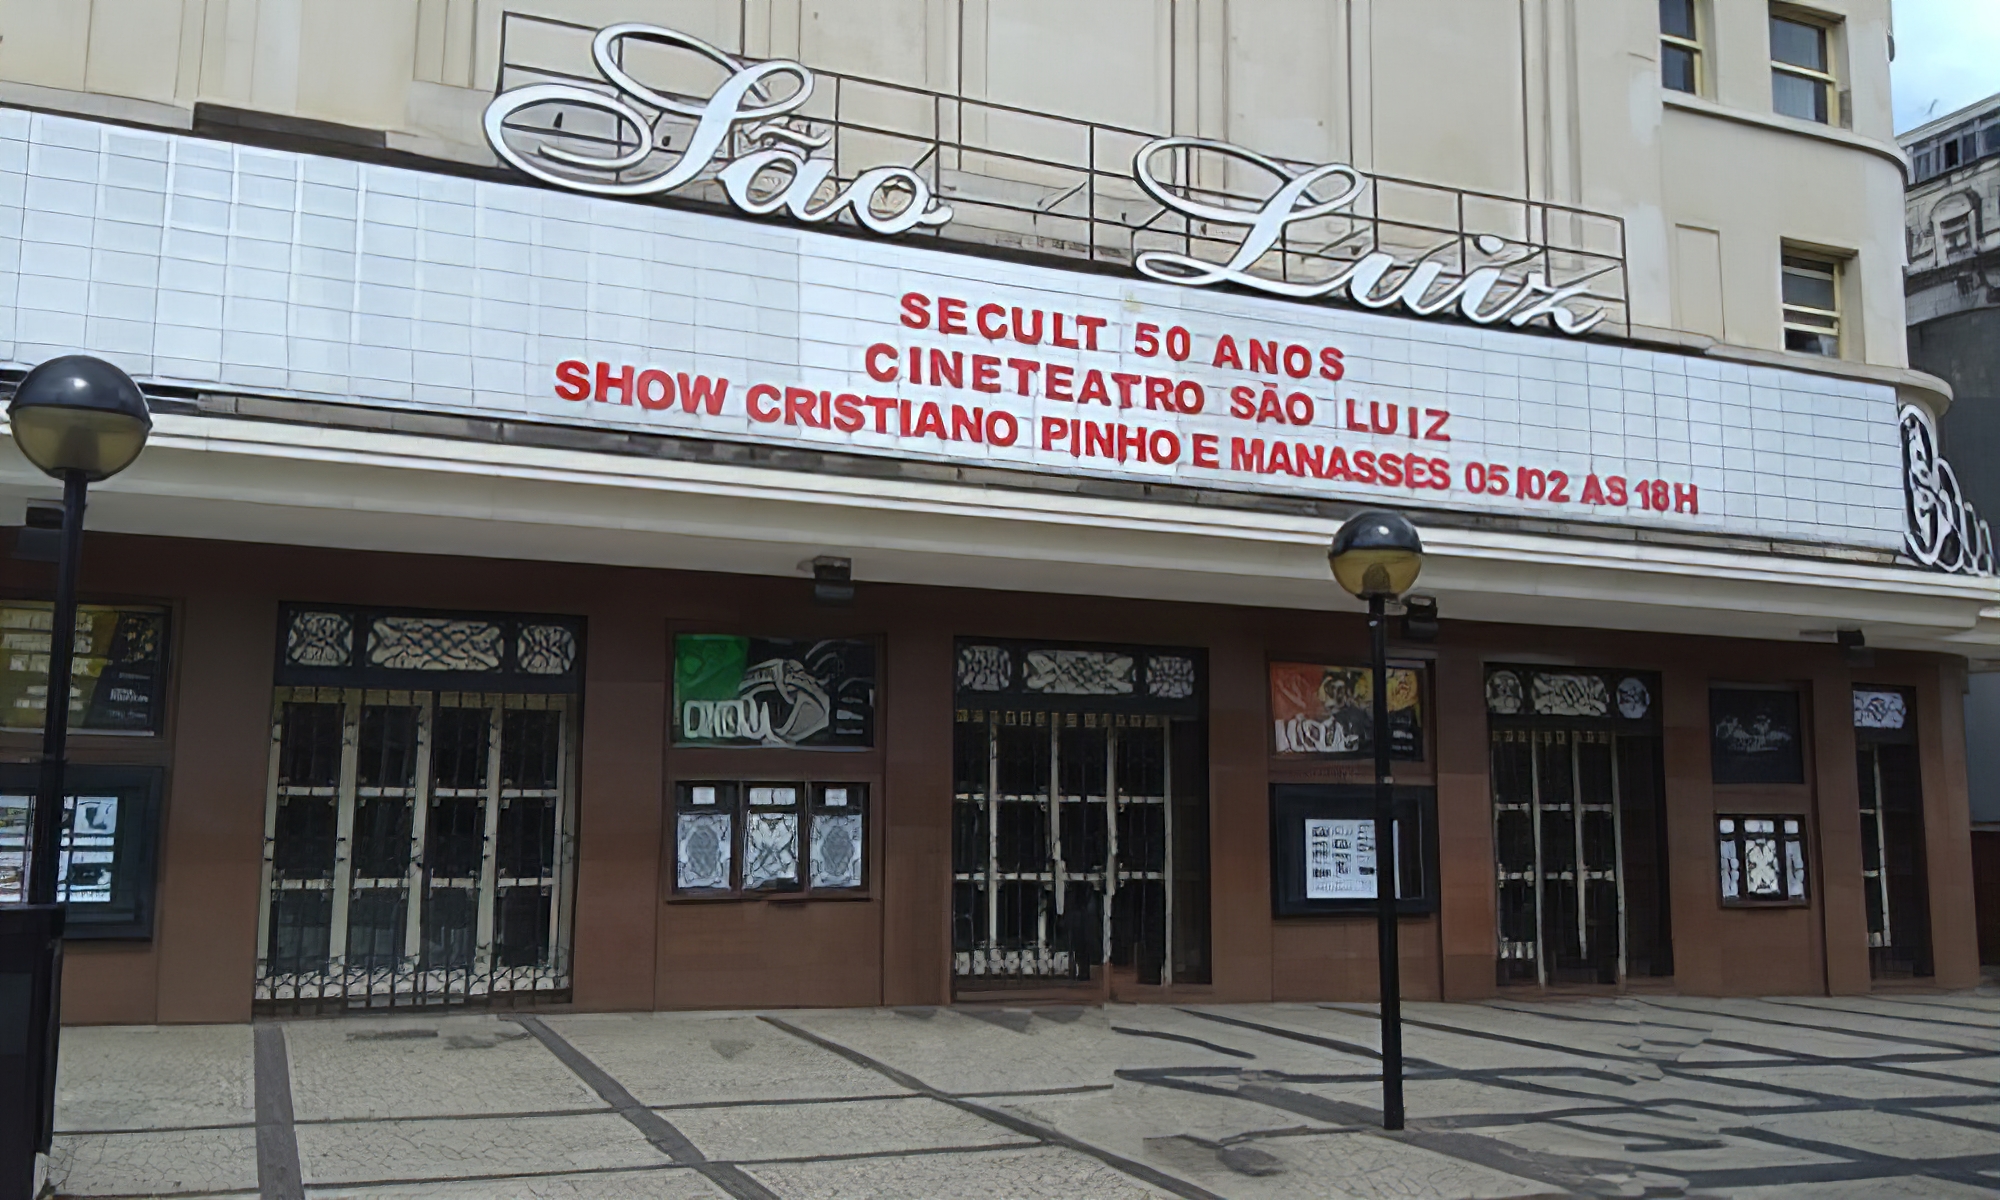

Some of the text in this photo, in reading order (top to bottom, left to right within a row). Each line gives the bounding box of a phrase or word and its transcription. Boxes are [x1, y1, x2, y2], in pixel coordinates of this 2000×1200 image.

[483, 22, 1607, 335] São Luiz
[865, 343, 1451, 441] CINETEATRO SÃO LUIZ
[900, 292, 1344, 381] SECULT 50 ANOS
[554, 360, 728, 416] SHOW
[746, 384, 1018, 447] CRISTIANO
[1041, 416, 1181, 466] PINHO
[1192, 433, 1219, 469] E
[1231, 437, 1451, 490] MANASSES
[1580, 474, 1628, 506] AS
[1635, 479, 1698, 512] 18H
